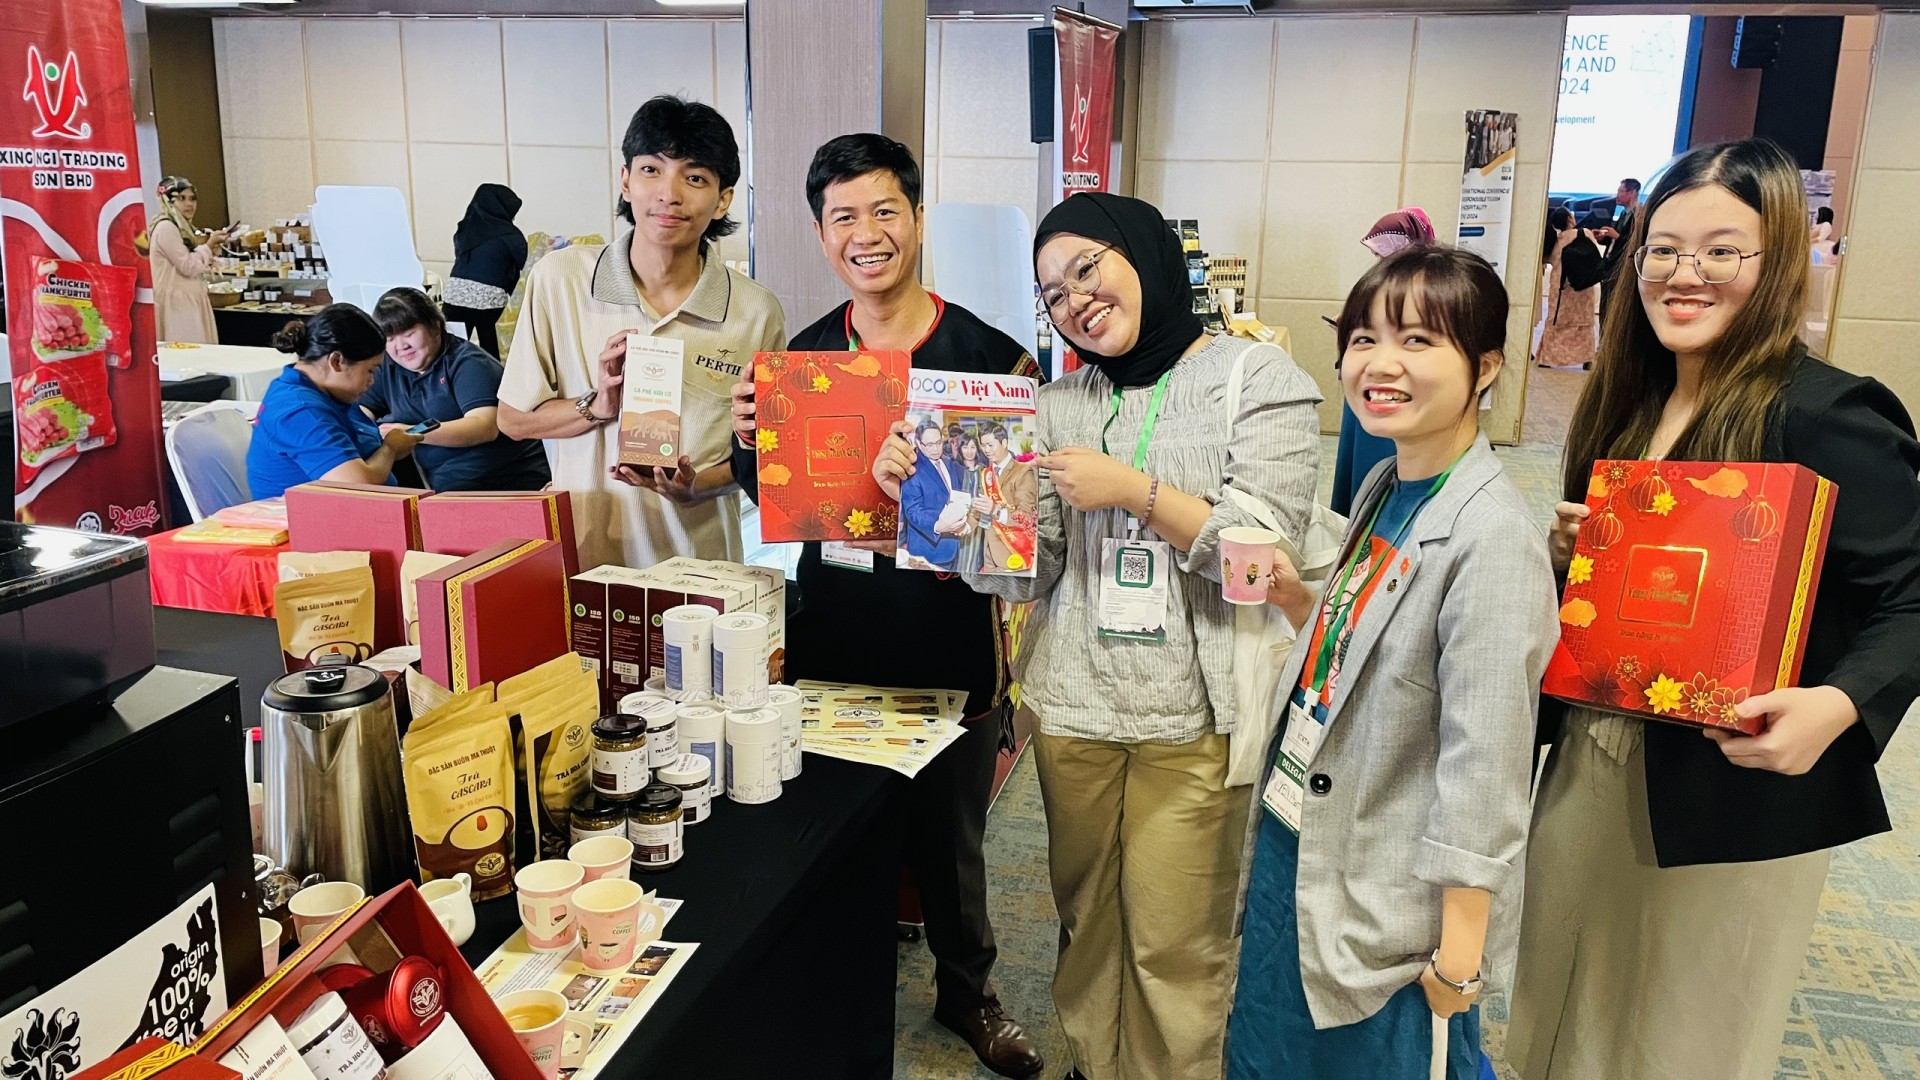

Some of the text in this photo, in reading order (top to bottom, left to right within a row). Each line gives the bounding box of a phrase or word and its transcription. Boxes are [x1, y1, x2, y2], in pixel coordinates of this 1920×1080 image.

[1577, 57, 1616, 72] AND
[63, 153, 125, 168] TRADING
[34, 173, 92, 187] SDN BHD
[48, 273, 90, 289] CHICKEN
[695, 354, 742, 377] PERTH
[910, 376, 1031, 401] OCOP Việt Nam
[470, 751, 480, 761] MA
[556, 768, 570, 780] TRÀ
[451, 777, 492, 800] CASCARA
[171, 941, 209, 978] origin
[148, 961, 210, 1026] 100%
[180, 998, 194, 1020] of
[265, 1057, 275, 1067] MA
[338, 1060, 354, 1073] TRÀ
[352, 1049, 364, 1061] HOA
